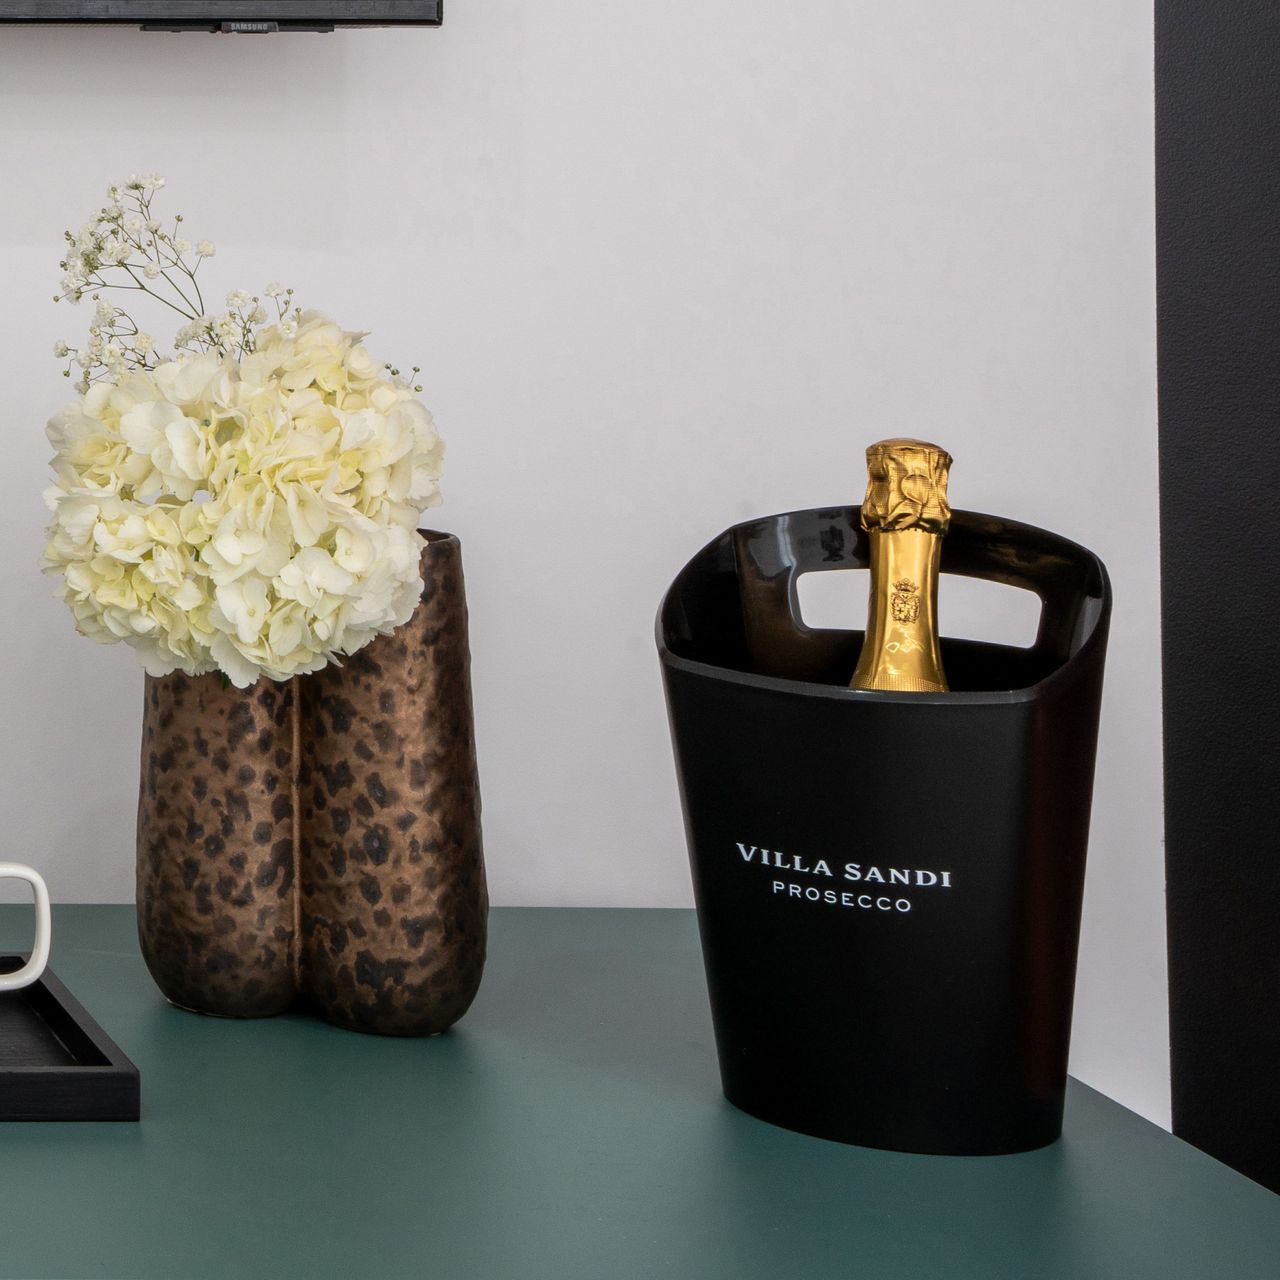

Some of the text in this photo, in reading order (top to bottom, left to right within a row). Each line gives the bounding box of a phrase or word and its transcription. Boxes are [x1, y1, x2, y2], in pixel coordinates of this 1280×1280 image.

[230, 23, 268, 31] SAMSUNG
[735, 842, 952, 888] VILLA SANDI
[773, 880, 912, 913] PROSECCO
